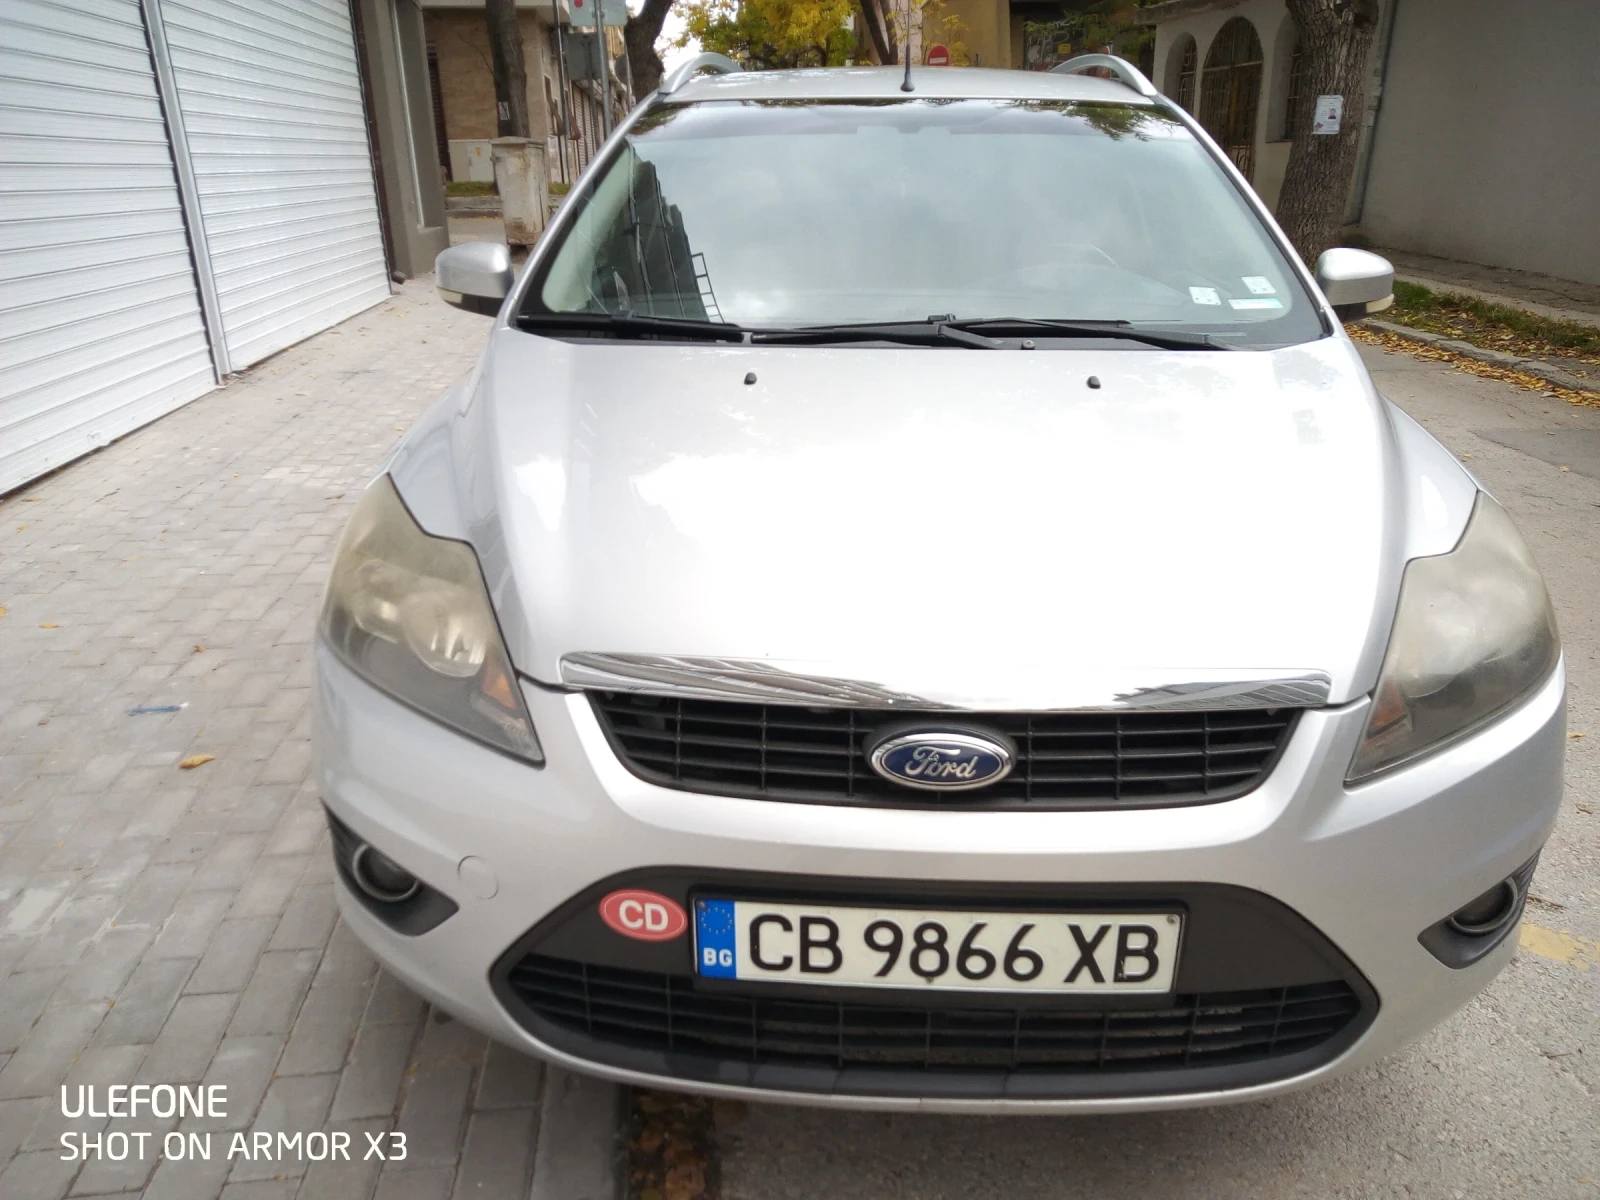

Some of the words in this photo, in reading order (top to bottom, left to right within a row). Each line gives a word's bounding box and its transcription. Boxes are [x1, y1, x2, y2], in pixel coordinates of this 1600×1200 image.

[904, 745, 979, 778] Ford
[618, 899, 669, 931] CD
[703, 947, 733, 967] BG
[749, 913, 843, 974] CB
[863, 919, 1044, 982] 9866
[1063, 923, 1160, 984] XB
